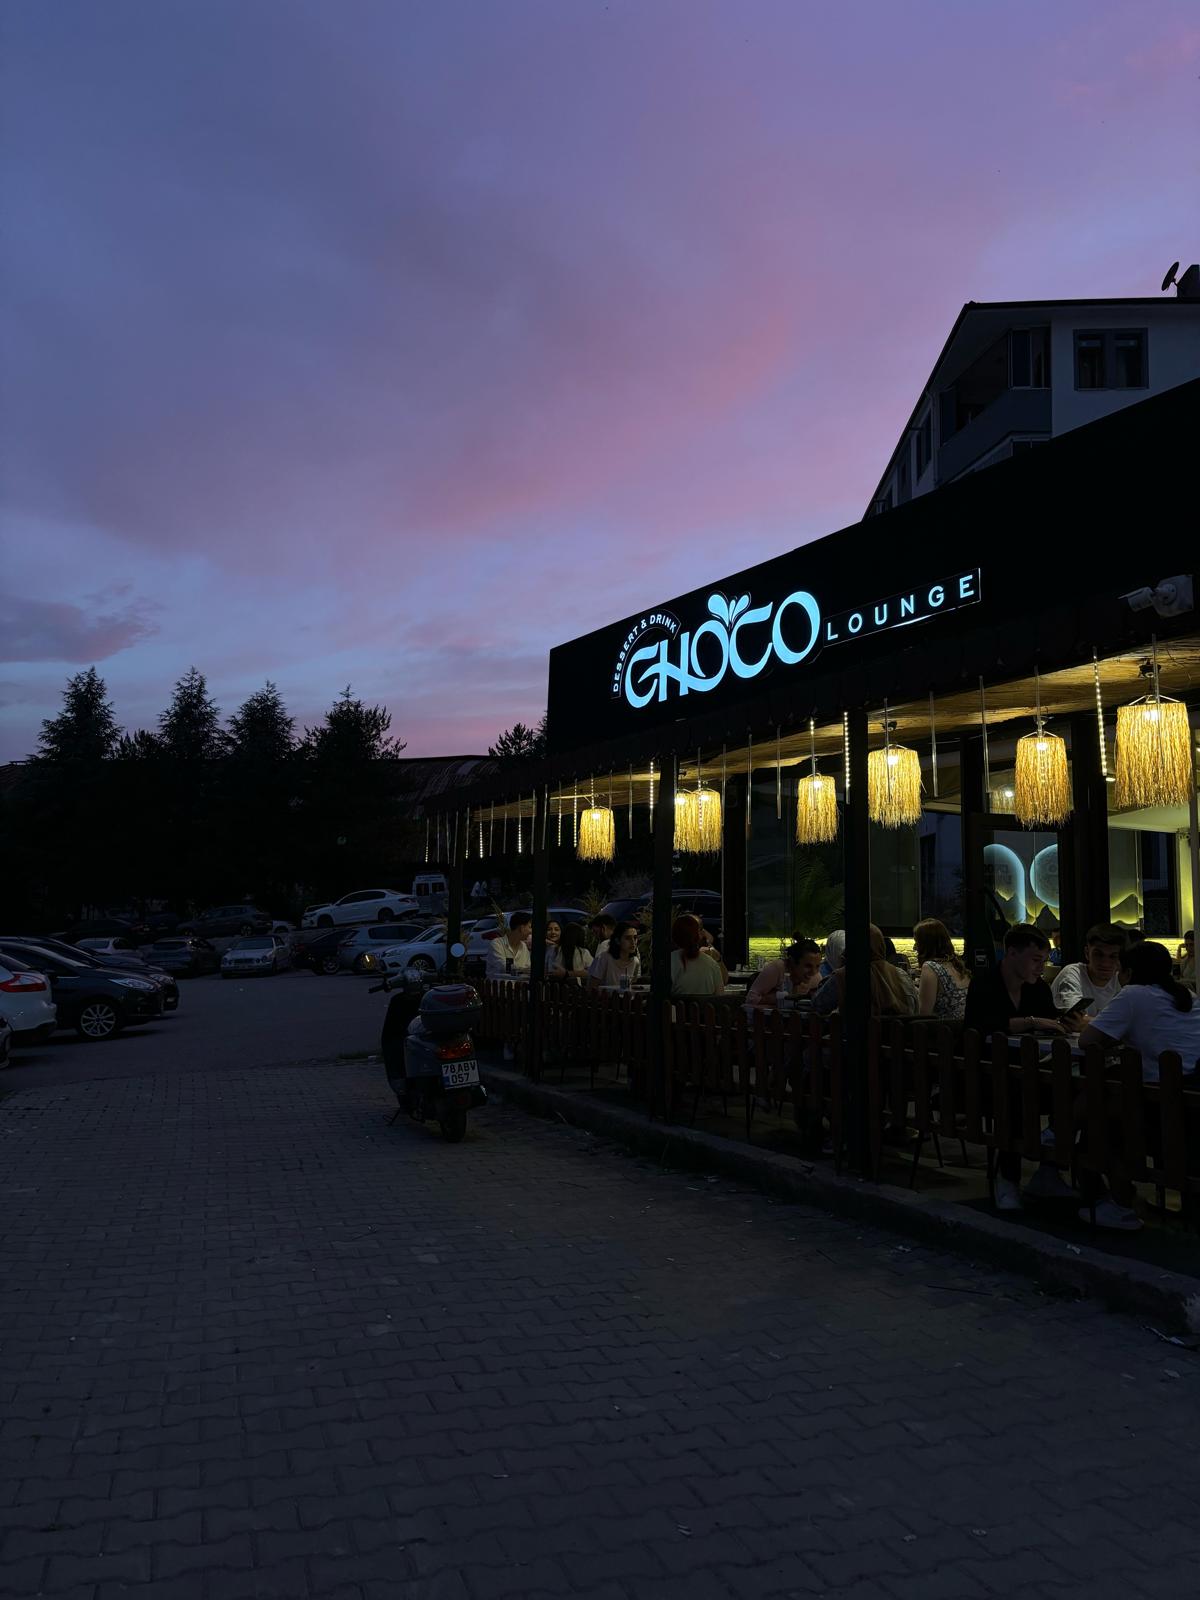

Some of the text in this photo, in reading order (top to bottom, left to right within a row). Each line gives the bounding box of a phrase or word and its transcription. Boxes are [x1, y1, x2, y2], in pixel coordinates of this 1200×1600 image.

[612, 613, 677, 692] DESSERT & DRINK
[625, 574, 974, 709] CHOCO LOUNGE
[451, 1072, 470, 1084] 057
